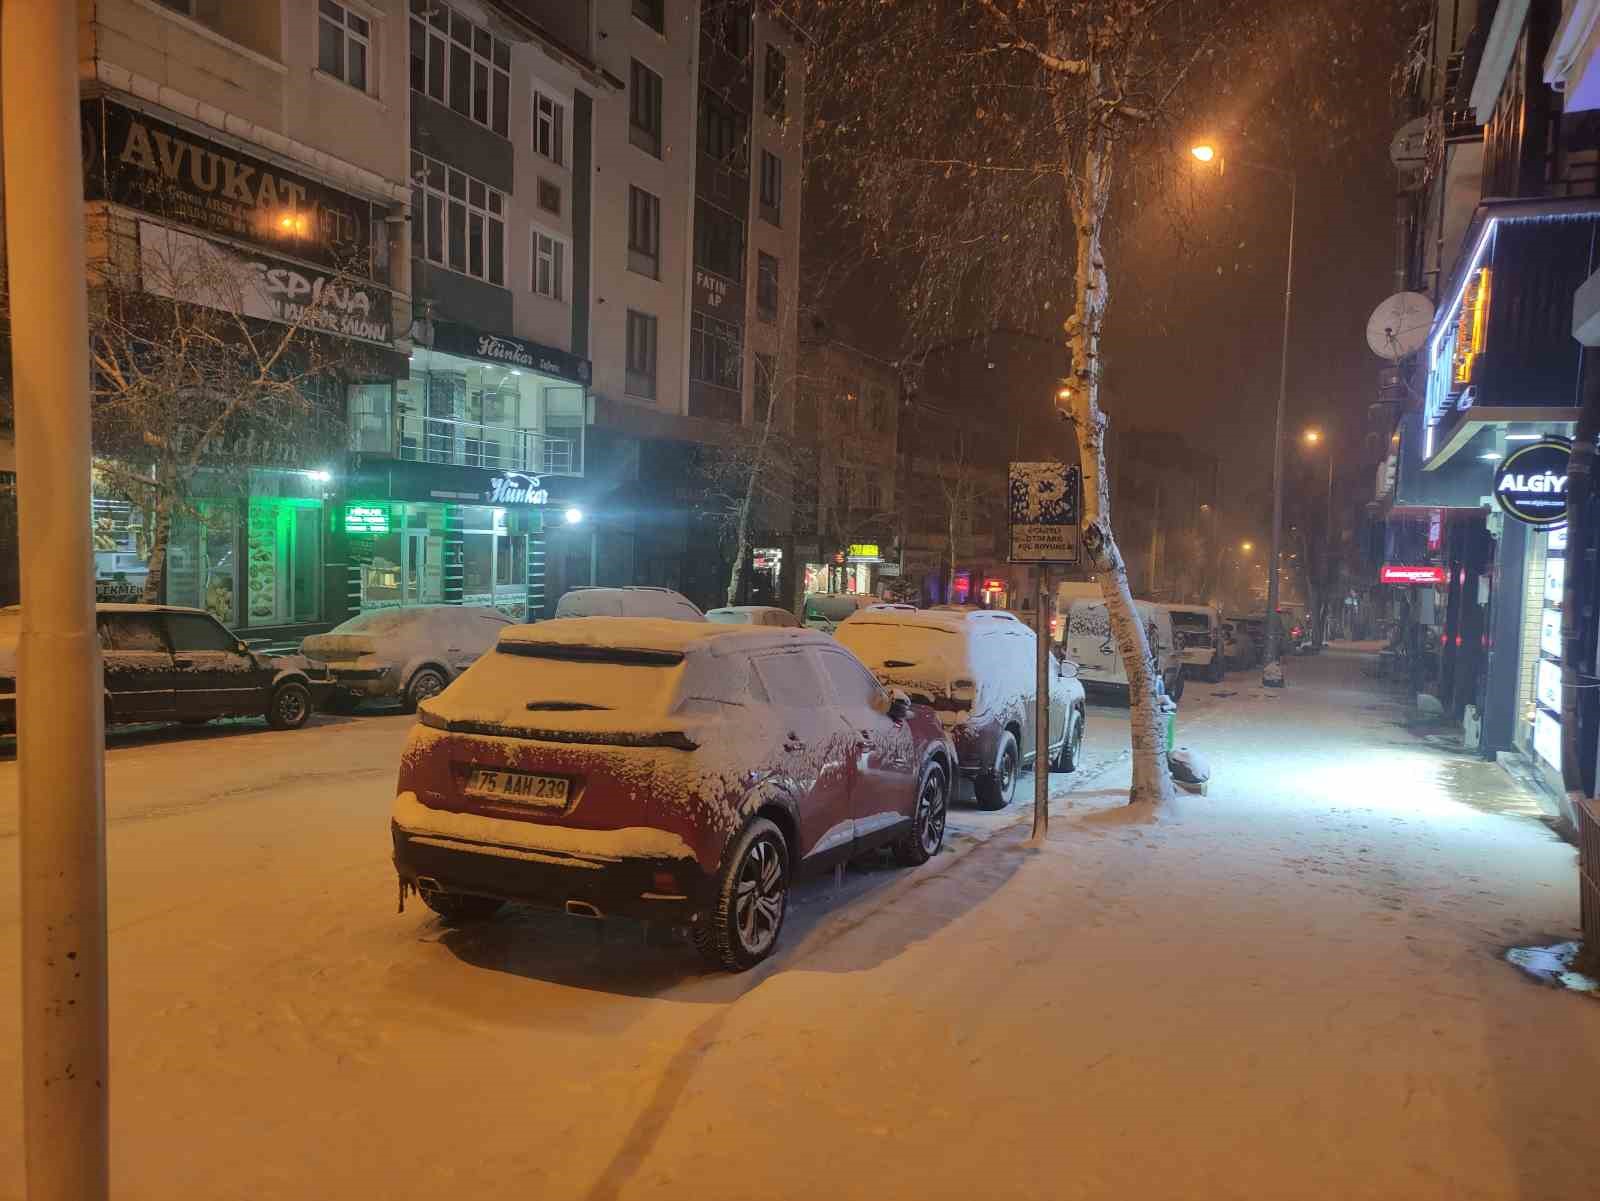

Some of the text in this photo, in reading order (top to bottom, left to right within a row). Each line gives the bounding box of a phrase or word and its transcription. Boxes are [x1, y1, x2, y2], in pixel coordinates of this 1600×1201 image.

[120, 121, 306, 209] AVUKAT
[340, 314, 386, 341] SALONU
[477, 335, 533, 365] Hünkar
[491, 471, 549, 504] Hünkar
[1497, 470, 1568, 493] ALGİY
[479, 771, 566, 800] 75 AAH 239
